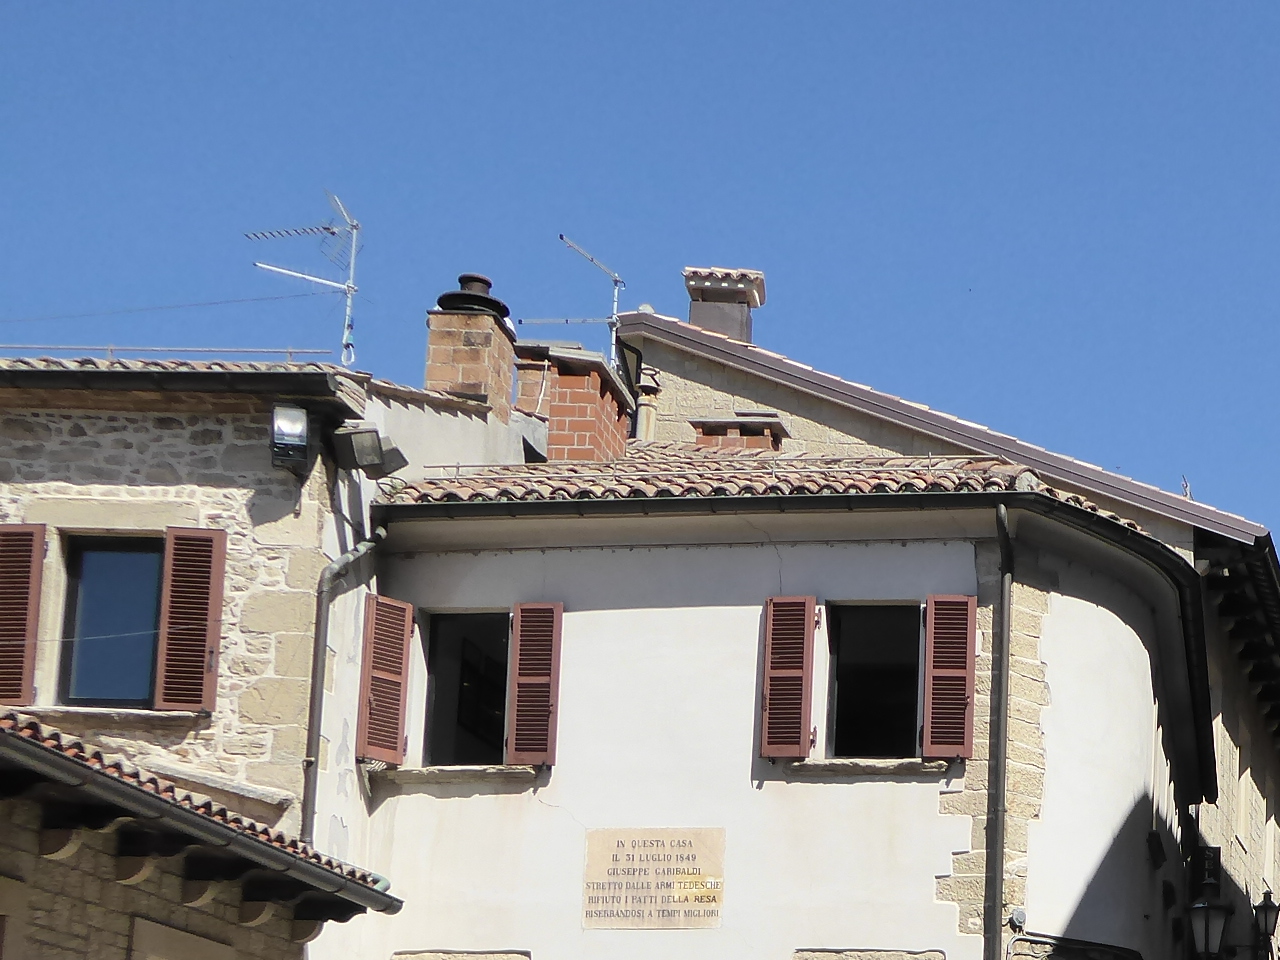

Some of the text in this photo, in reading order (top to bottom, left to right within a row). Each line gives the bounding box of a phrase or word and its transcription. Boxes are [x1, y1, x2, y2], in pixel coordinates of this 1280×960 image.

[616, 839, 693, 848] IN QUESTA CASA
[612, 853, 697, 862] IL 31 LUGLIO 1849
[607, 867, 701, 876] GIUSEPPE GARIBALDI
[585, 881, 721, 890] STRETTO DALLE ARMI TEDESCHE
[631, 895, 658, 904] PATTI
[661, 895, 689, 904] DELLA
[694, 895, 717, 904] RESA
[585, 909, 645, 918] RISERBANDOSI
[656, 909, 680, 918] TEMPI
[684, 909, 719, 918] MIGLIORI
